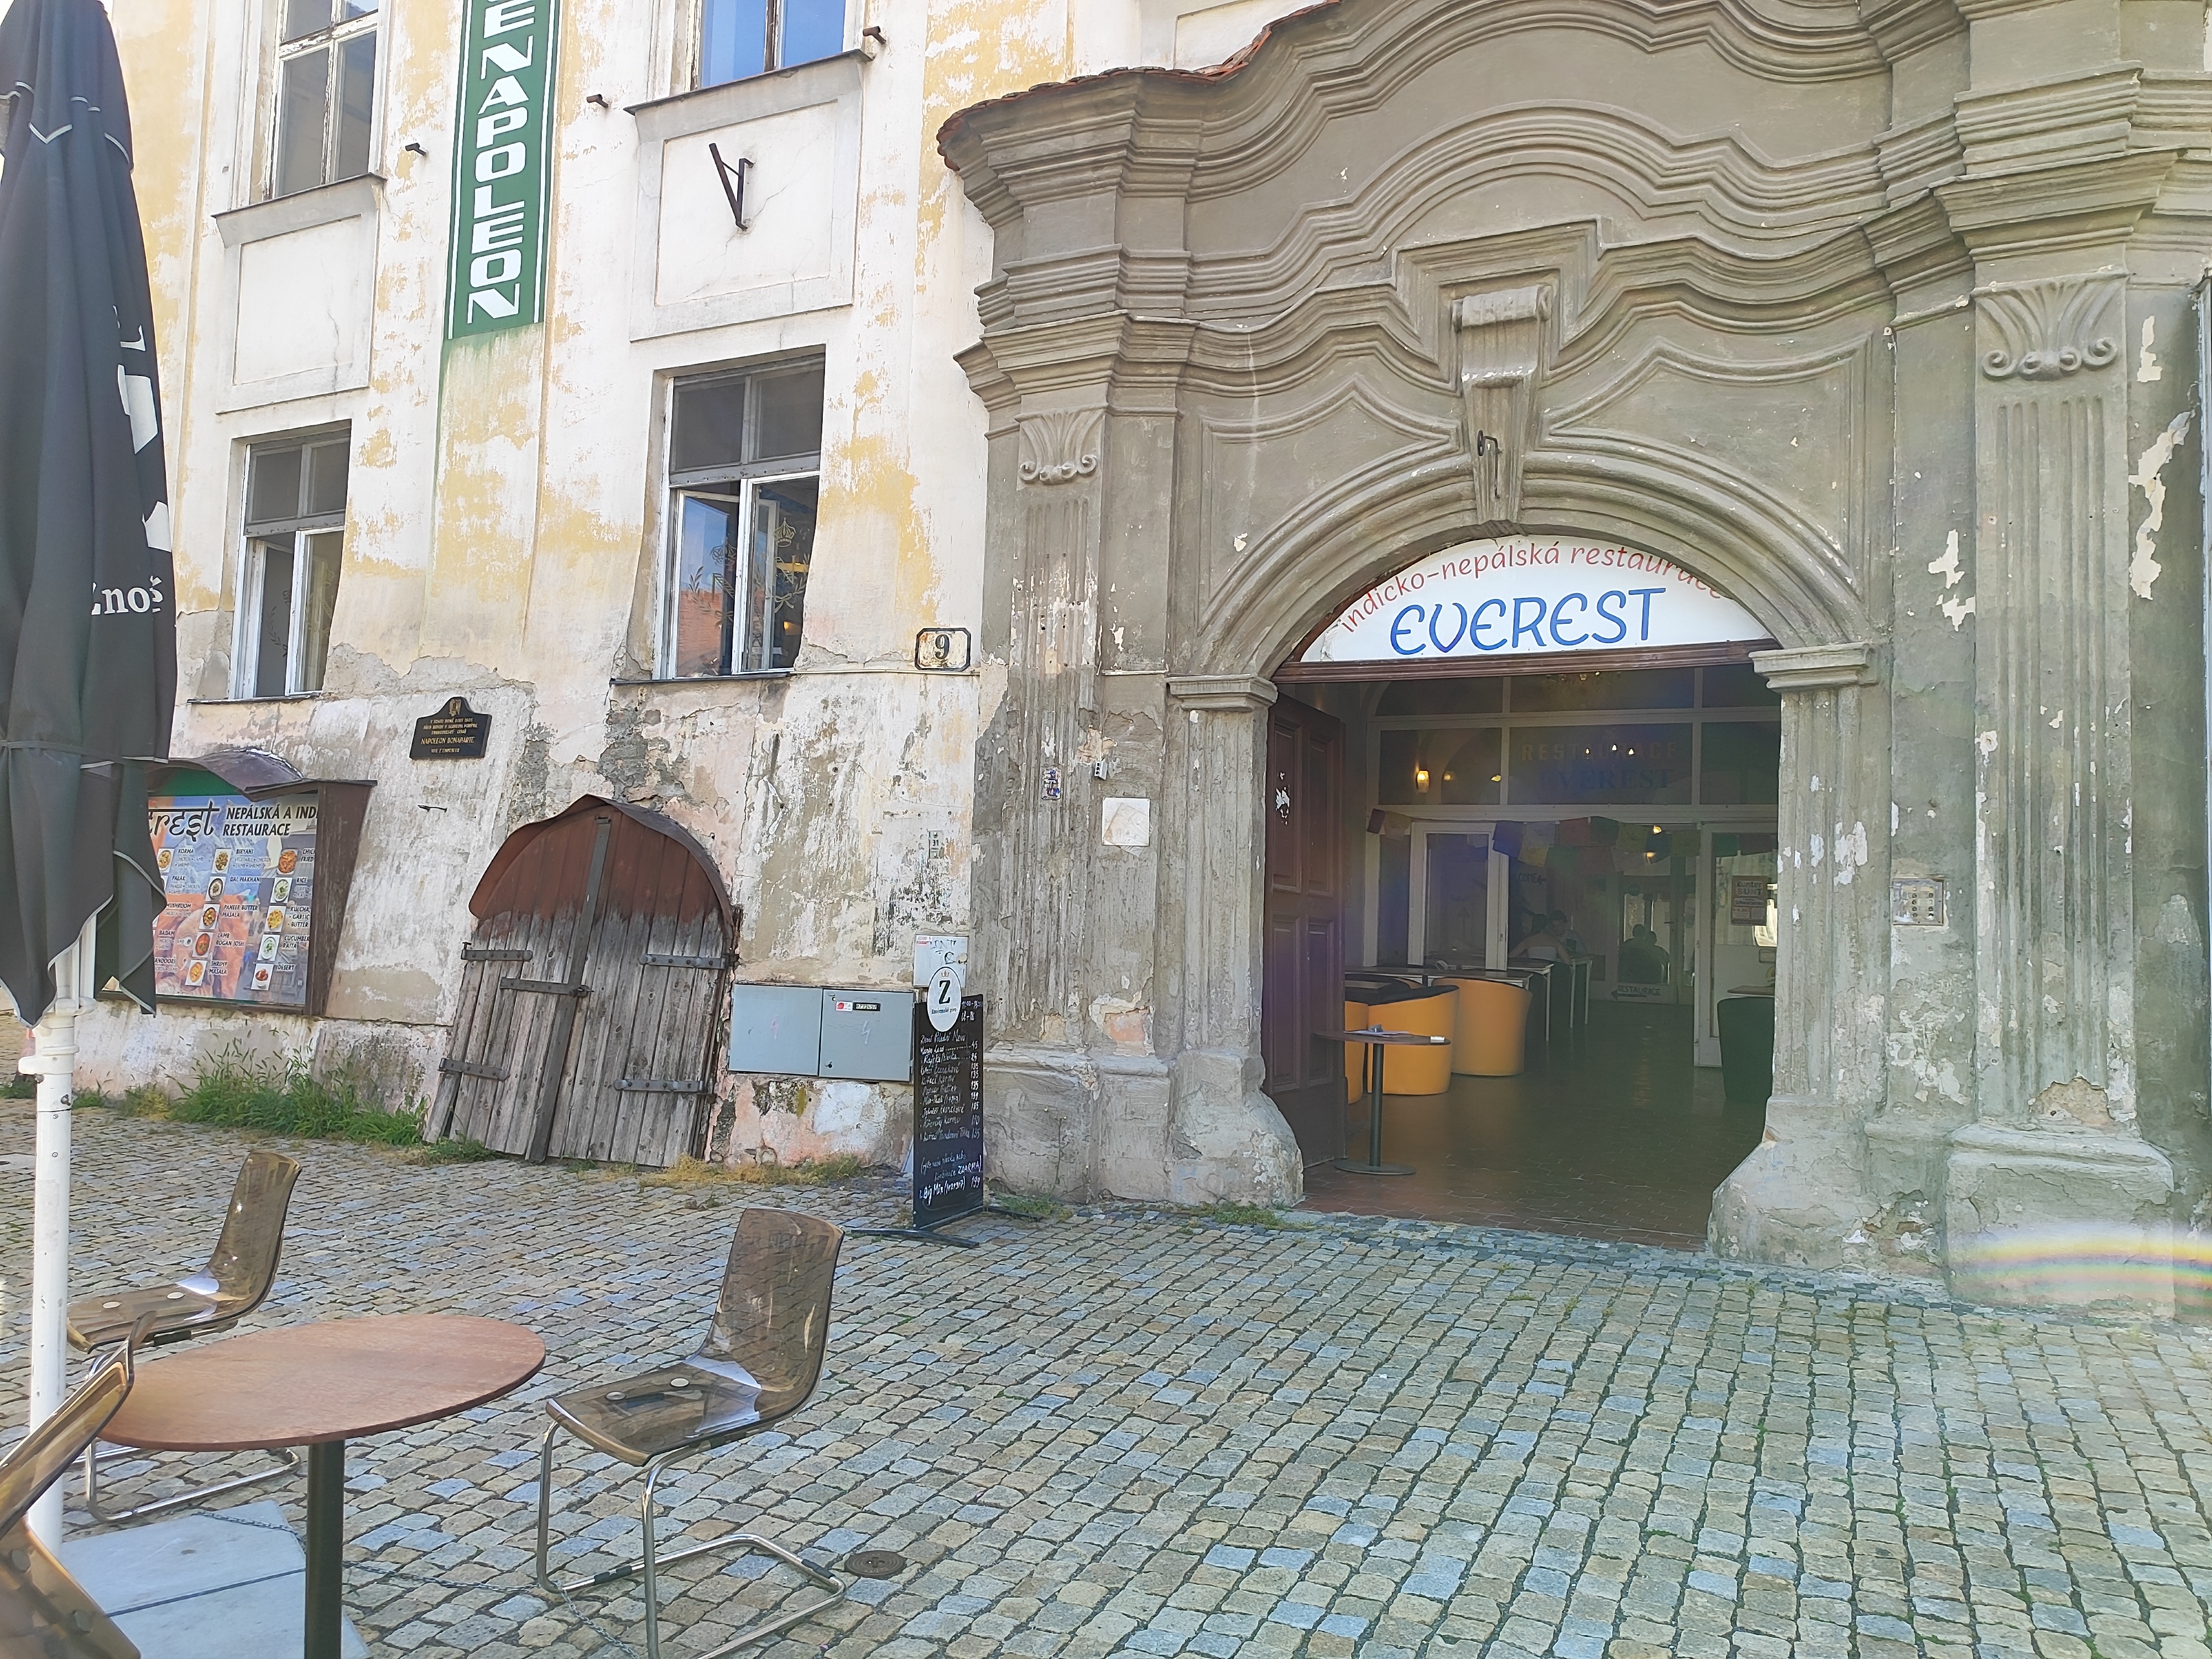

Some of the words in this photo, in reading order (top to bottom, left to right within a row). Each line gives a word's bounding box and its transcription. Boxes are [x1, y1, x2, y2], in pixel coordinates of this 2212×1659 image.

[1341, 541, 1559, 633] indicko-nepálská
[1390, 587, 1666, 655] EVEREST
[936, 634, 951, 660] 9
[447, 736, 476, 744] BONAPARTE
[1522, 741, 1677, 761] RESTAURACE
[1539, 769, 1674, 790] EVEREST
[226, 804, 280, 820] NEPÁLSKÁ
[283, 806, 291, 819] A
[222, 823, 291, 836] RESTAURACE
[938, 979, 951, 1005] Z
[952, 1029, 966, 1042] Menu
